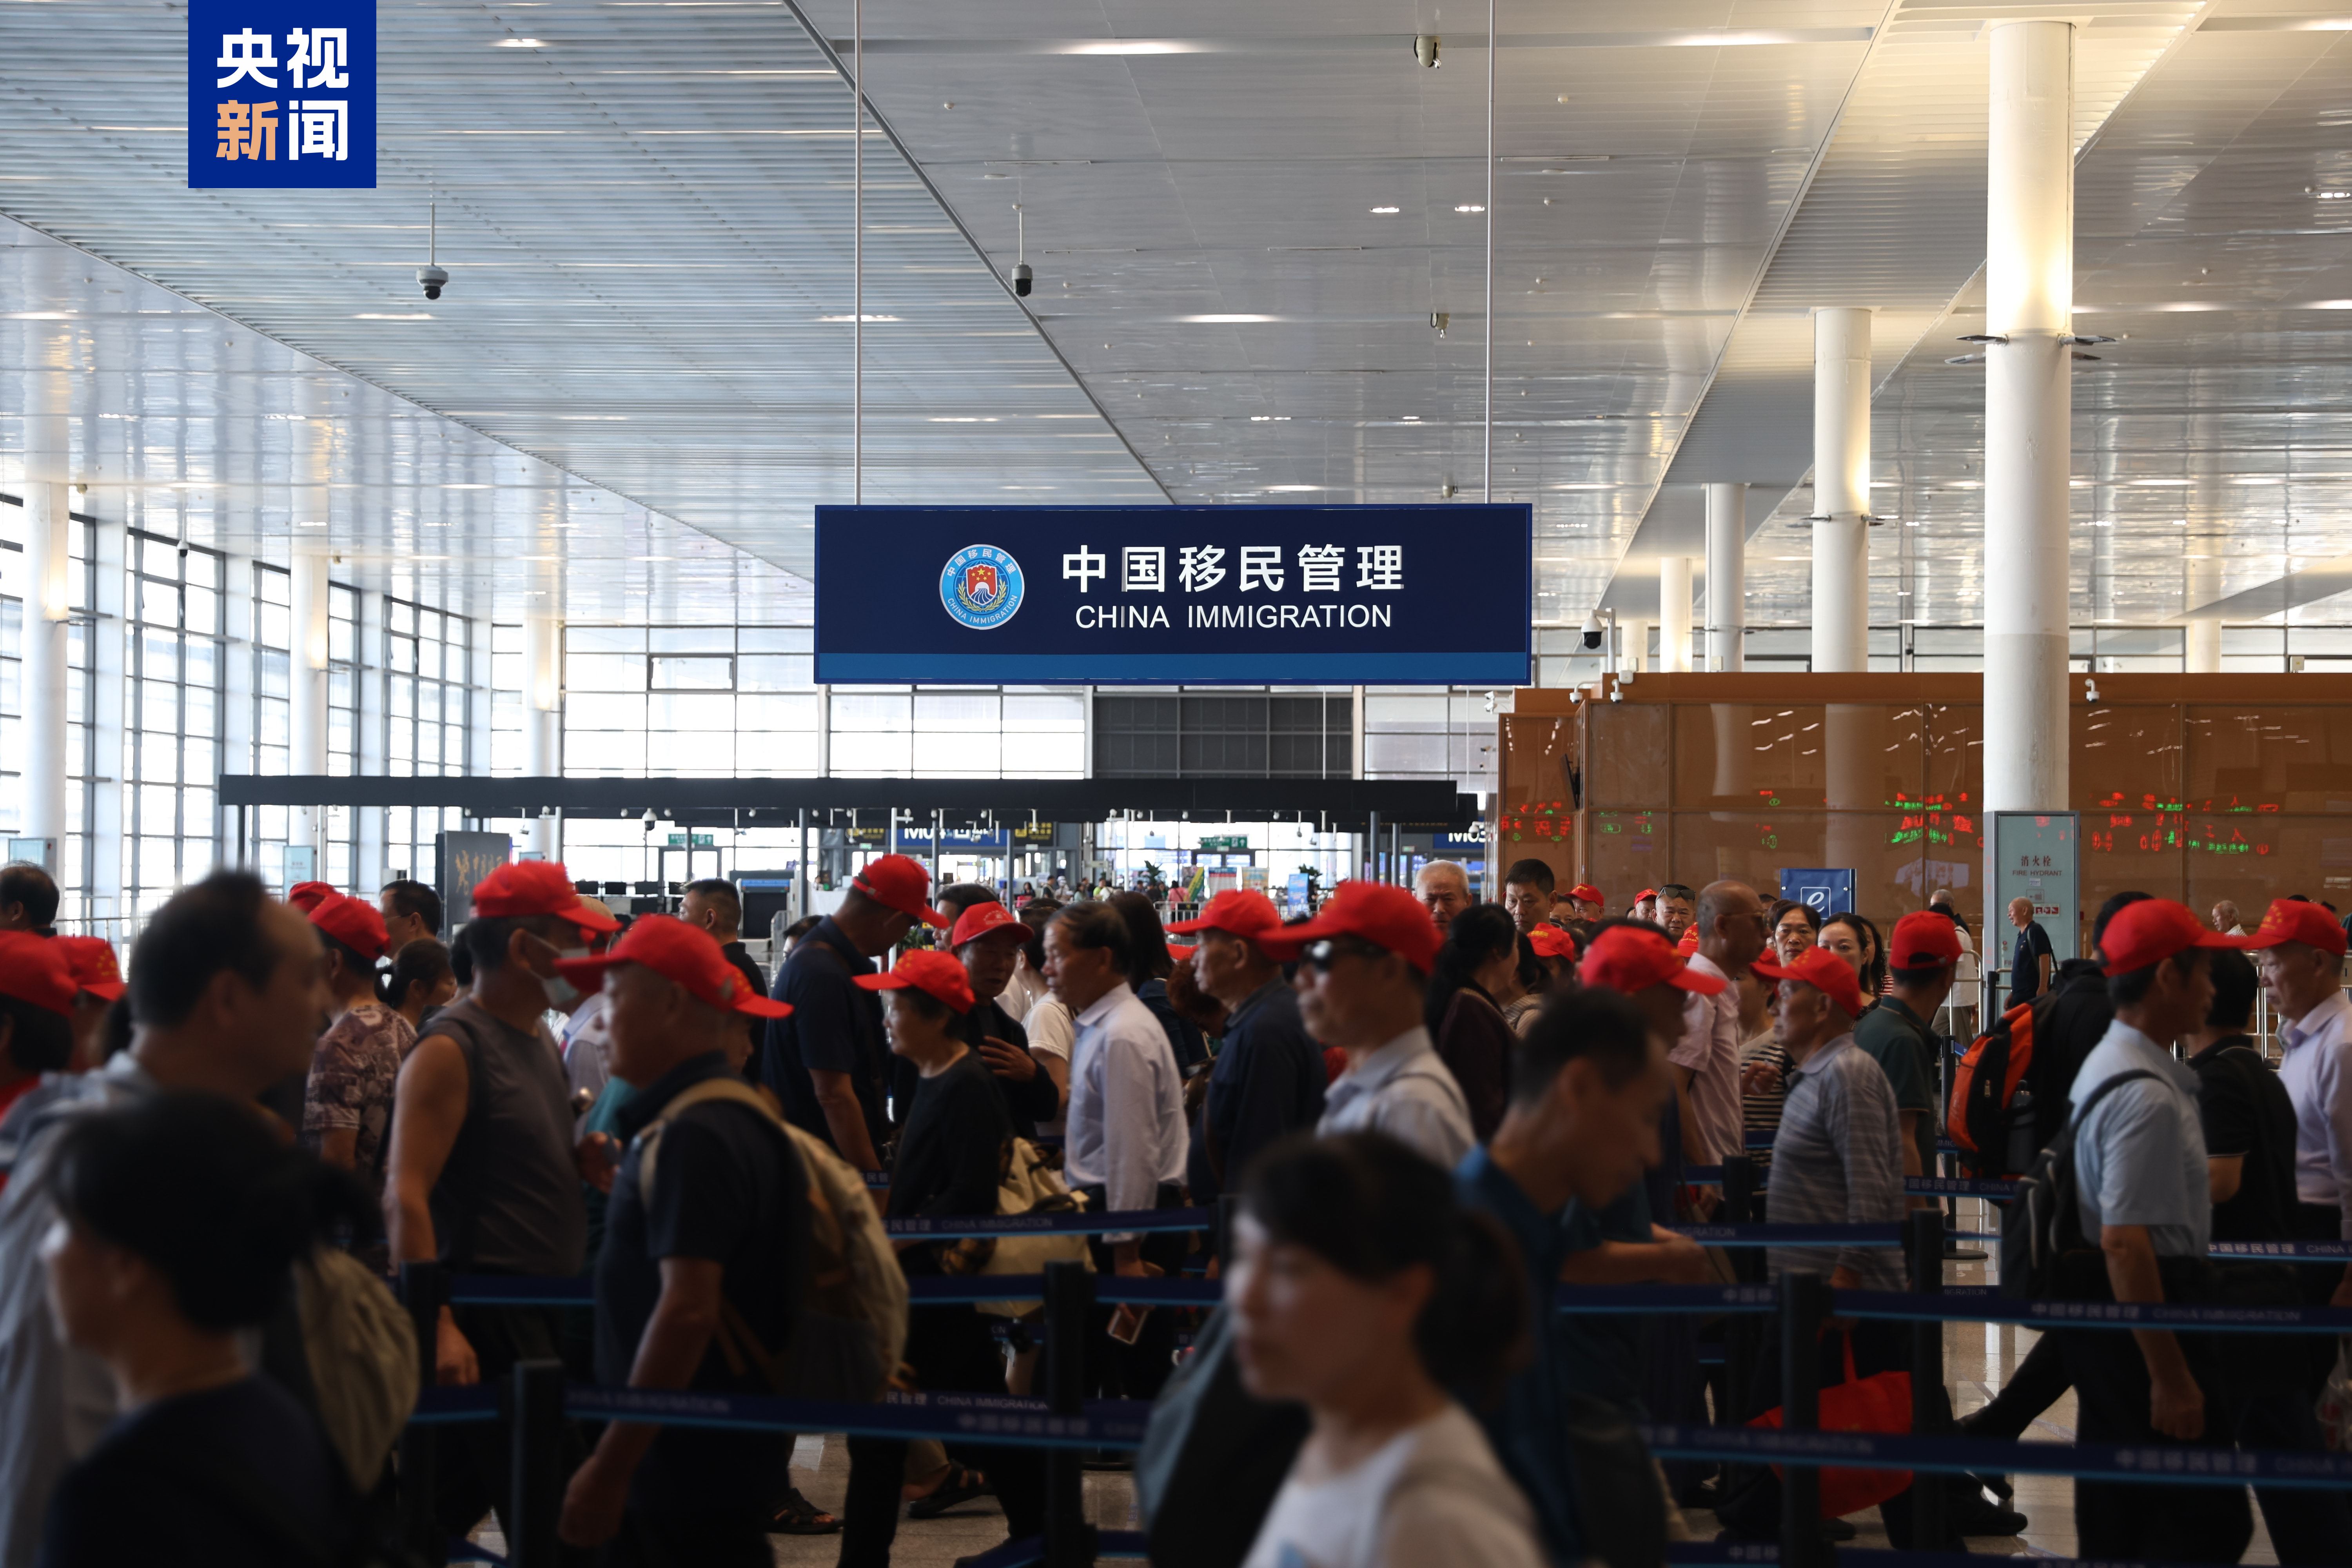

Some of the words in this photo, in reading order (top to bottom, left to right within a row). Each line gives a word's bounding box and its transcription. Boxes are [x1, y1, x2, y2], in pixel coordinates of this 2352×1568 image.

[947, 548, 1016, 577] 中国移民管理
[1063, 544, 1403, 593] 中国移民管理
[948, 598, 966, 620] CHINA
[969, 595, 1018, 624] IMMIGRATION
[1076, 606, 1170, 628] CHINA
[1189, 605, 1390, 628] IMMIGRATION
[2021, 855, 2051, 867] 消火栓
